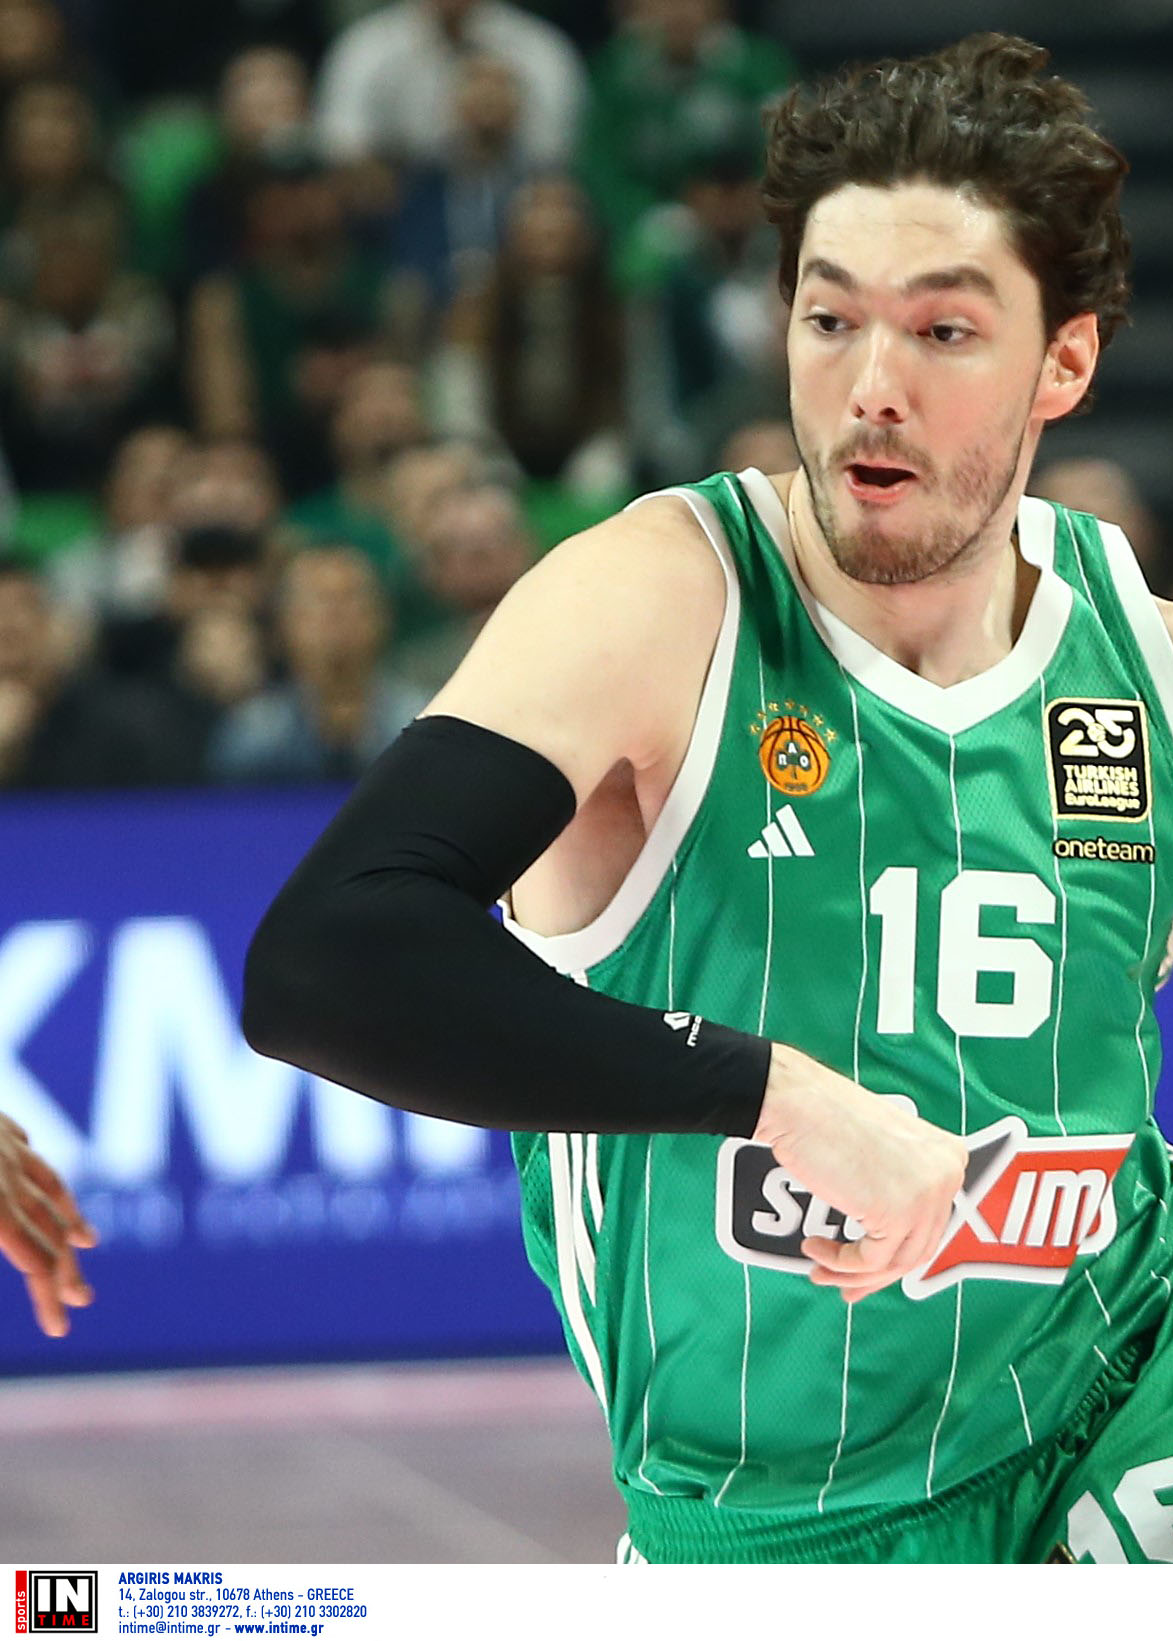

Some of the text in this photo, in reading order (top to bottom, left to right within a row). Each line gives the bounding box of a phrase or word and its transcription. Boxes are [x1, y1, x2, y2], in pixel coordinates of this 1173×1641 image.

[1057, 707, 1136, 759] 25
[1063, 764, 1138, 782] TURKISH
[1064, 778, 1140, 797] AIRLINES
[1054, 838, 1154, 862] oneteam
[869, 866, 1057, 1038] 16
